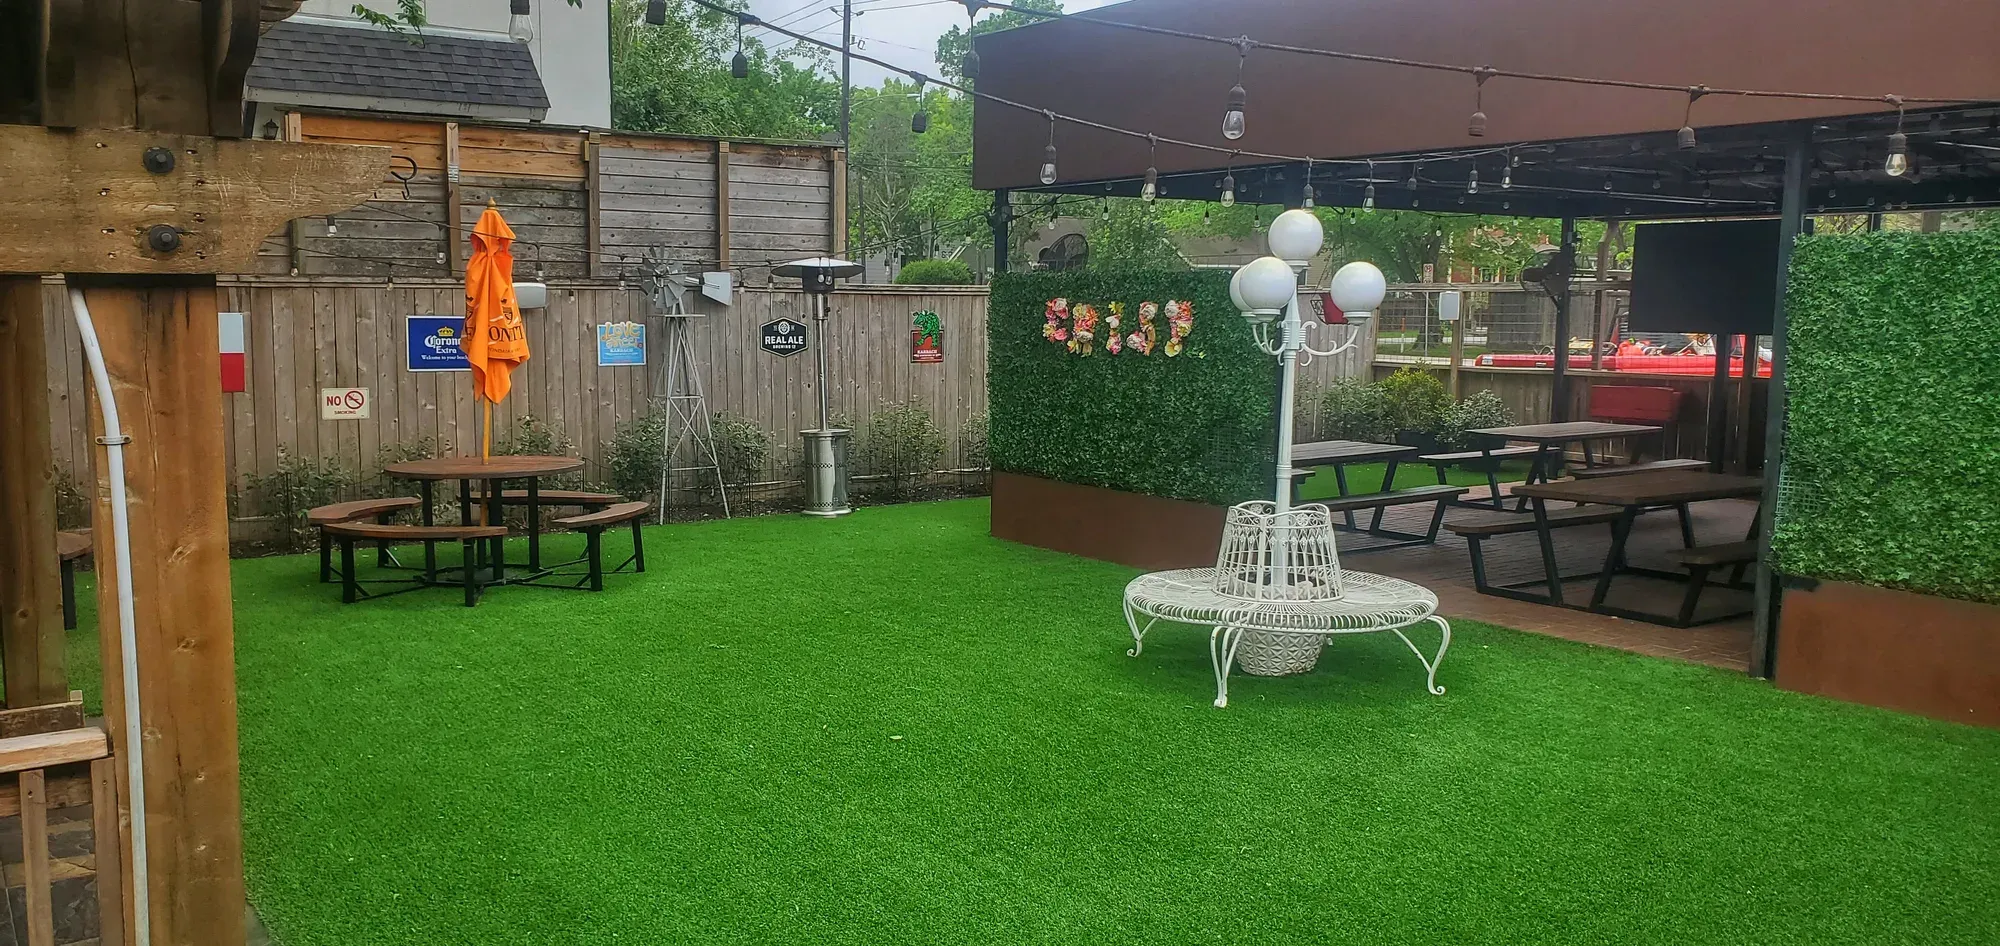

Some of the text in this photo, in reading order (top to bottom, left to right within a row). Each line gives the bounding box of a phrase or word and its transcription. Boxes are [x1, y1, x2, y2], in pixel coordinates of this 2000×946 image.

[764, 335, 804, 345] REAL ALE
[436, 346, 457, 354] Extra
[326, 396, 341, 406] NO
